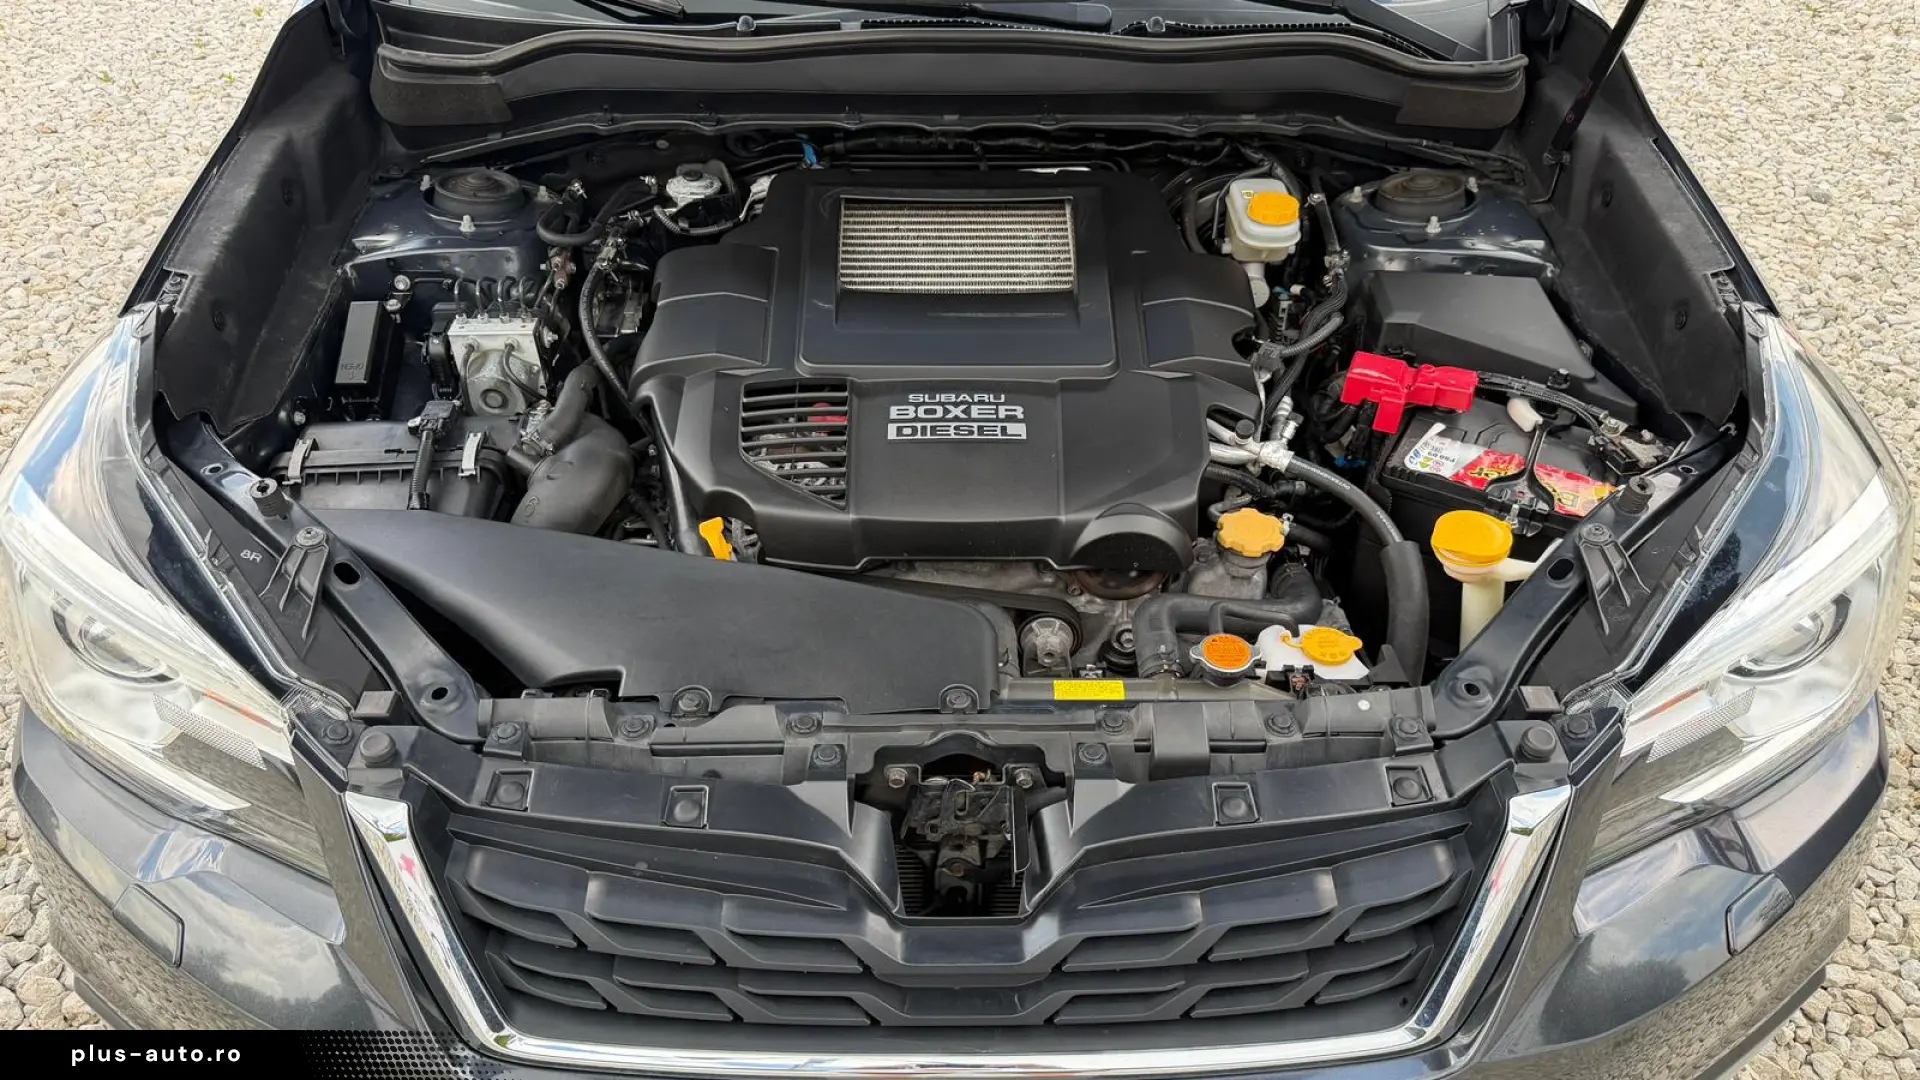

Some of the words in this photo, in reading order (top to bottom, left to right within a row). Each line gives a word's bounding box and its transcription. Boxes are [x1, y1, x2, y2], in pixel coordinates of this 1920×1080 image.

[908, 393, 1006, 403] SUBARU
[889, 404, 1025, 420] BOXER
[895, 424, 1022, 438] DIESEL
[240, 549, 263, 563] 8R
